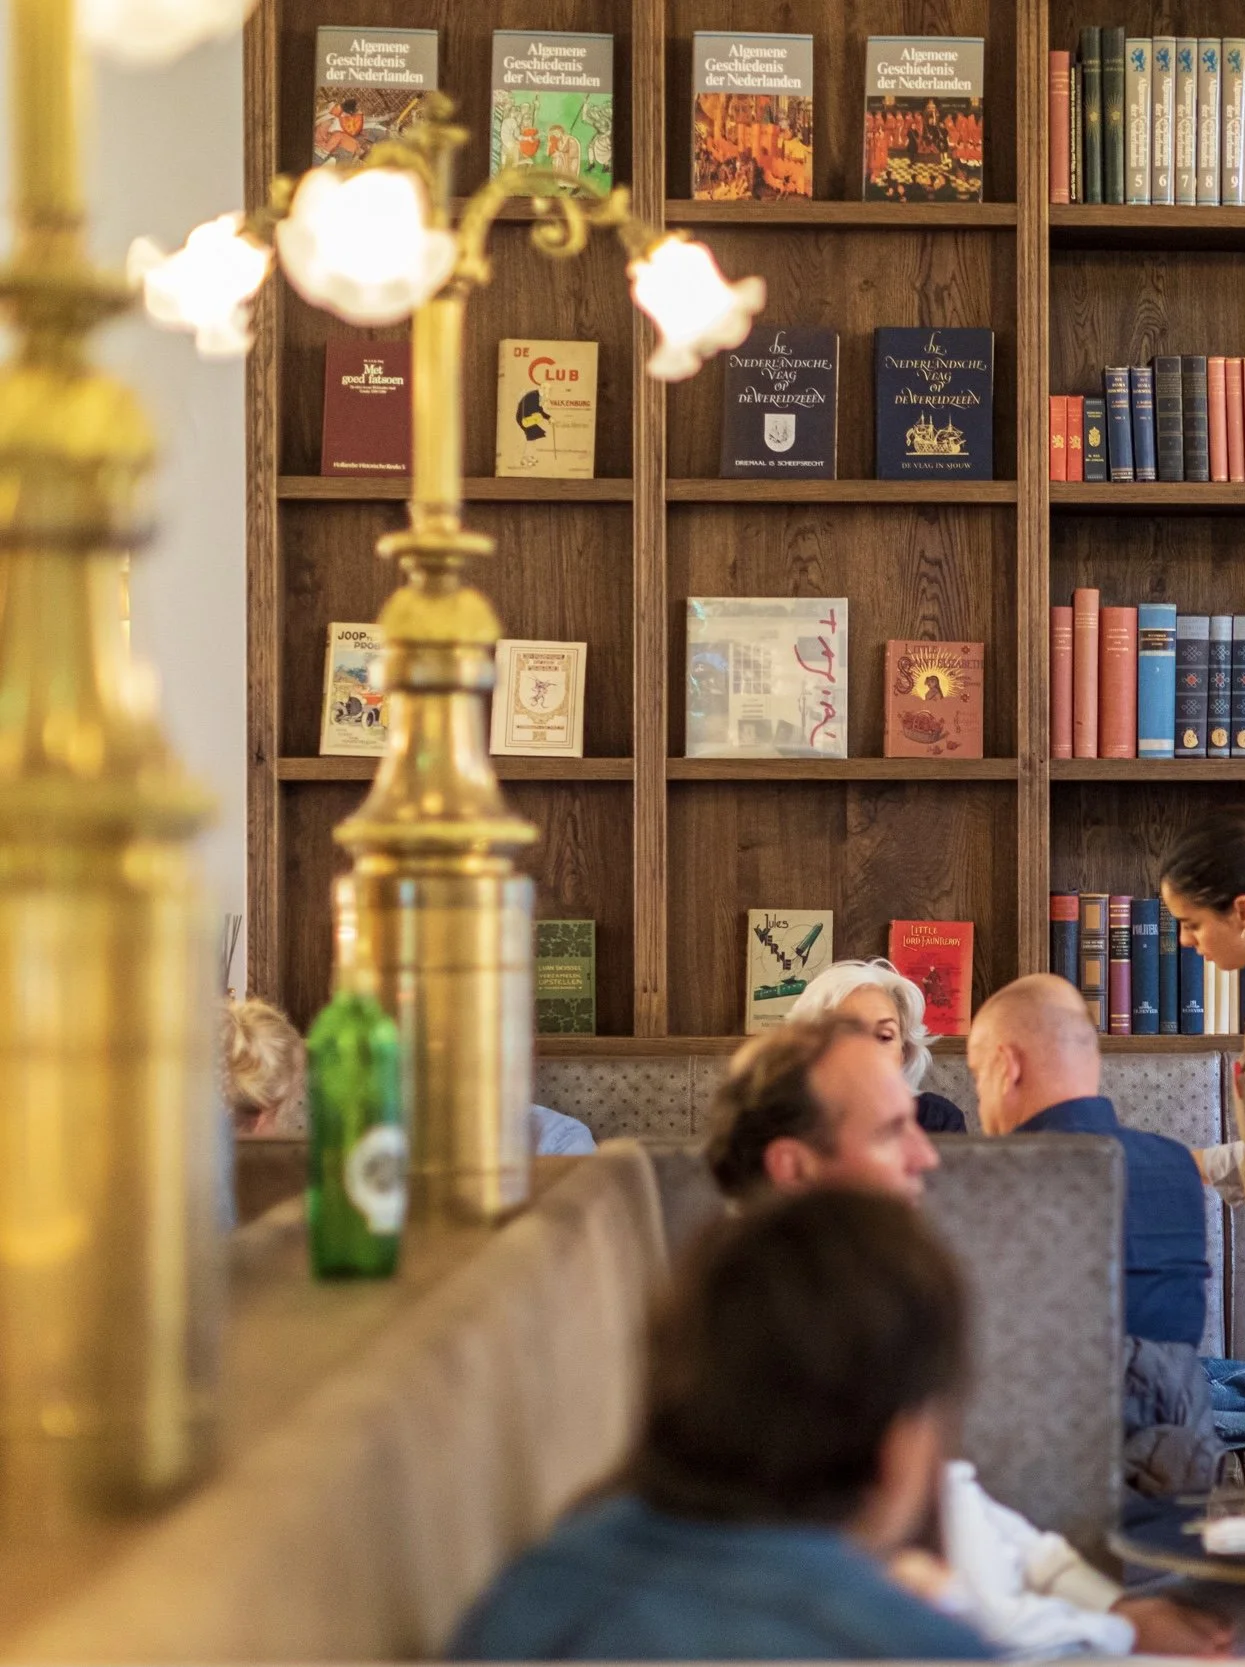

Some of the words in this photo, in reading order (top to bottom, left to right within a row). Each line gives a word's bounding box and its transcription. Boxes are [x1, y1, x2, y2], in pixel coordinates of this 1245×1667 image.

[350, 39, 410, 54] Algemene
[527, 42, 587, 58] Algemene
[728, 43, 788, 58] Algemene
[326, 52, 406, 68] Geschiedenis
[900, 48, 958, 62] Algemene
[503, 56, 583, 72] Geschiedenis
[705, 58, 784, 73] Geschiedenis
[877, 61, 955, 76] Geschiedenis
[326, 67, 346, 80] der
[348, 67, 424, 83] Nederlanden
[503, 70, 524, 83] der
[526, 70, 600, 87] Nederlanden
[705, 72, 725, 85] der
[727, 72, 801, 88] Nederlanden
[877, 76, 896, 89] der
[899, 76, 972, 90] Nederlanden
[1135, 174, 1143, 187] 5
[1159, 174, 1167, 187] 6
[1181, 175, 1189, 187] 7
[1205, 175, 1213, 188] 8
[1230, 175, 1238, 188] 9
[769, 331, 793, 355] DE
[923, 331, 948, 356] DE
[514, 347, 530, 357] DE
[363, 363, 383, 374] Met
[729, 354, 833, 370] NEDERLANDSCHE
[885, 355, 988, 371] NEDERLANDSCHE
[528, 356, 579, 386] CLUB
[761, 368, 797, 383] VLAG
[916, 369, 952, 384] VLAG
[341, 374, 366, 385] goed
[368, 373, 404, 385] fatsoen
[774, 380, 791, 391] OP
[929, 381, 945, 392] OP
[338, 631, 367, 640] JOOP
[764, 913, 789, 930] Jules
[911, 925, 937, 936] LITTLE
[754, 925, 792, 970] VERNE
[903, 936, 921, 950] LORD
